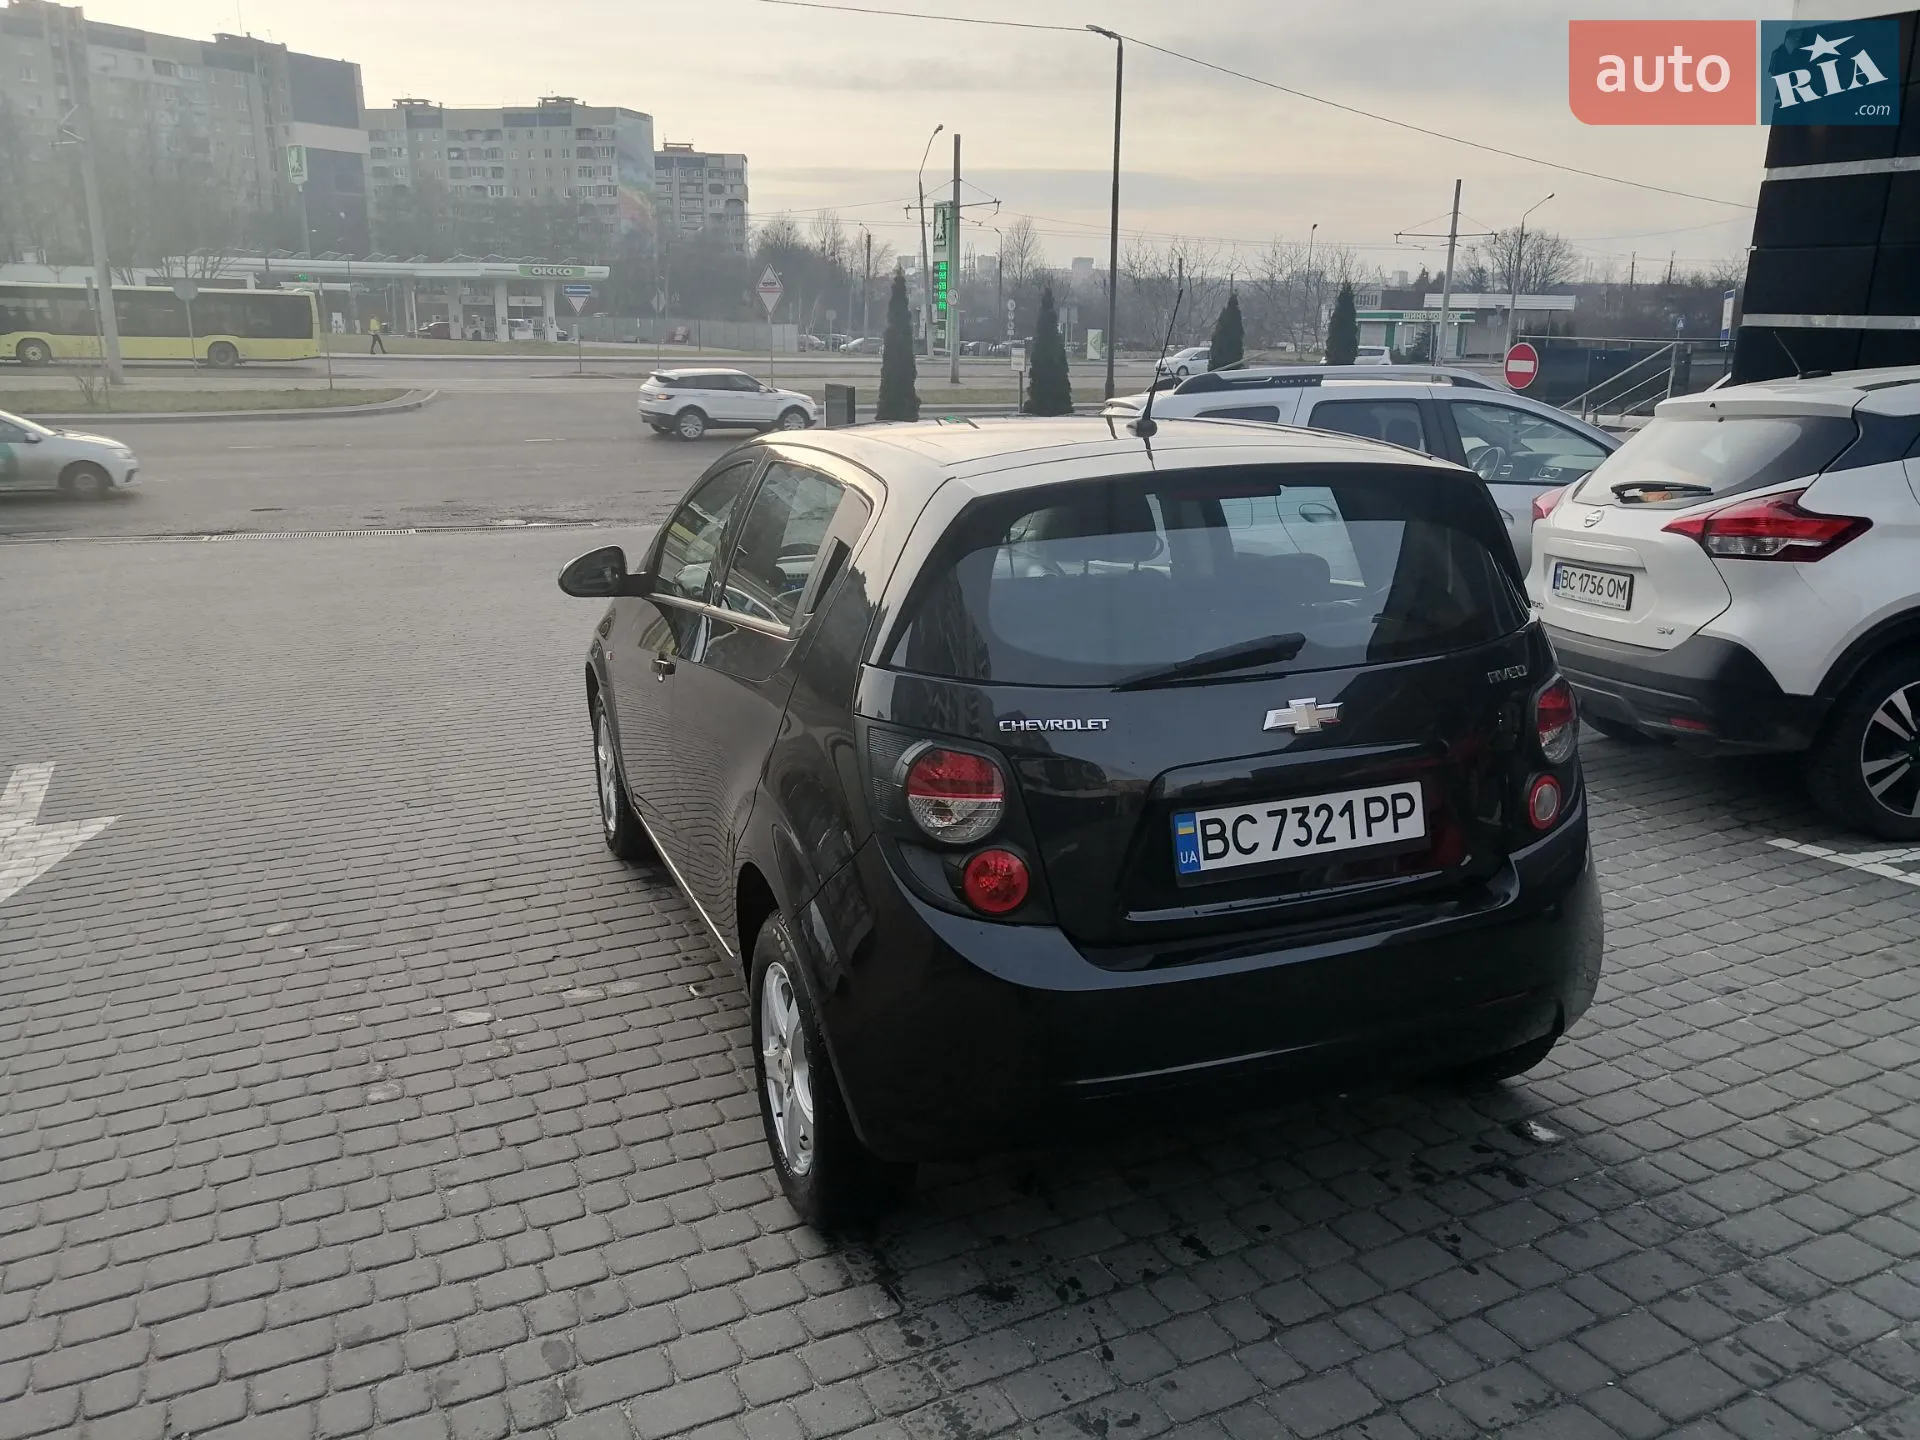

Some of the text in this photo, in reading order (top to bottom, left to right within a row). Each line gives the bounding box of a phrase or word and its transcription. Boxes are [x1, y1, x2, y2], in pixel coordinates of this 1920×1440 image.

[531, 267, 573, 276] OKKO
[1403, 312, 1461, 321] ШИНОМОАЖ
[1561, 570, 1576, 590] BC
[1578, 574, 1604, 596] 1756
[1607, 578, 1628, 600] OM
[1487, 664, 1528, 684] AVEO
[999, 718, 1110, 732] CHEVROLET
[1200, 791, 1416, 861] BC 7321 PP
[1180, 851, 1198, 864] UA
